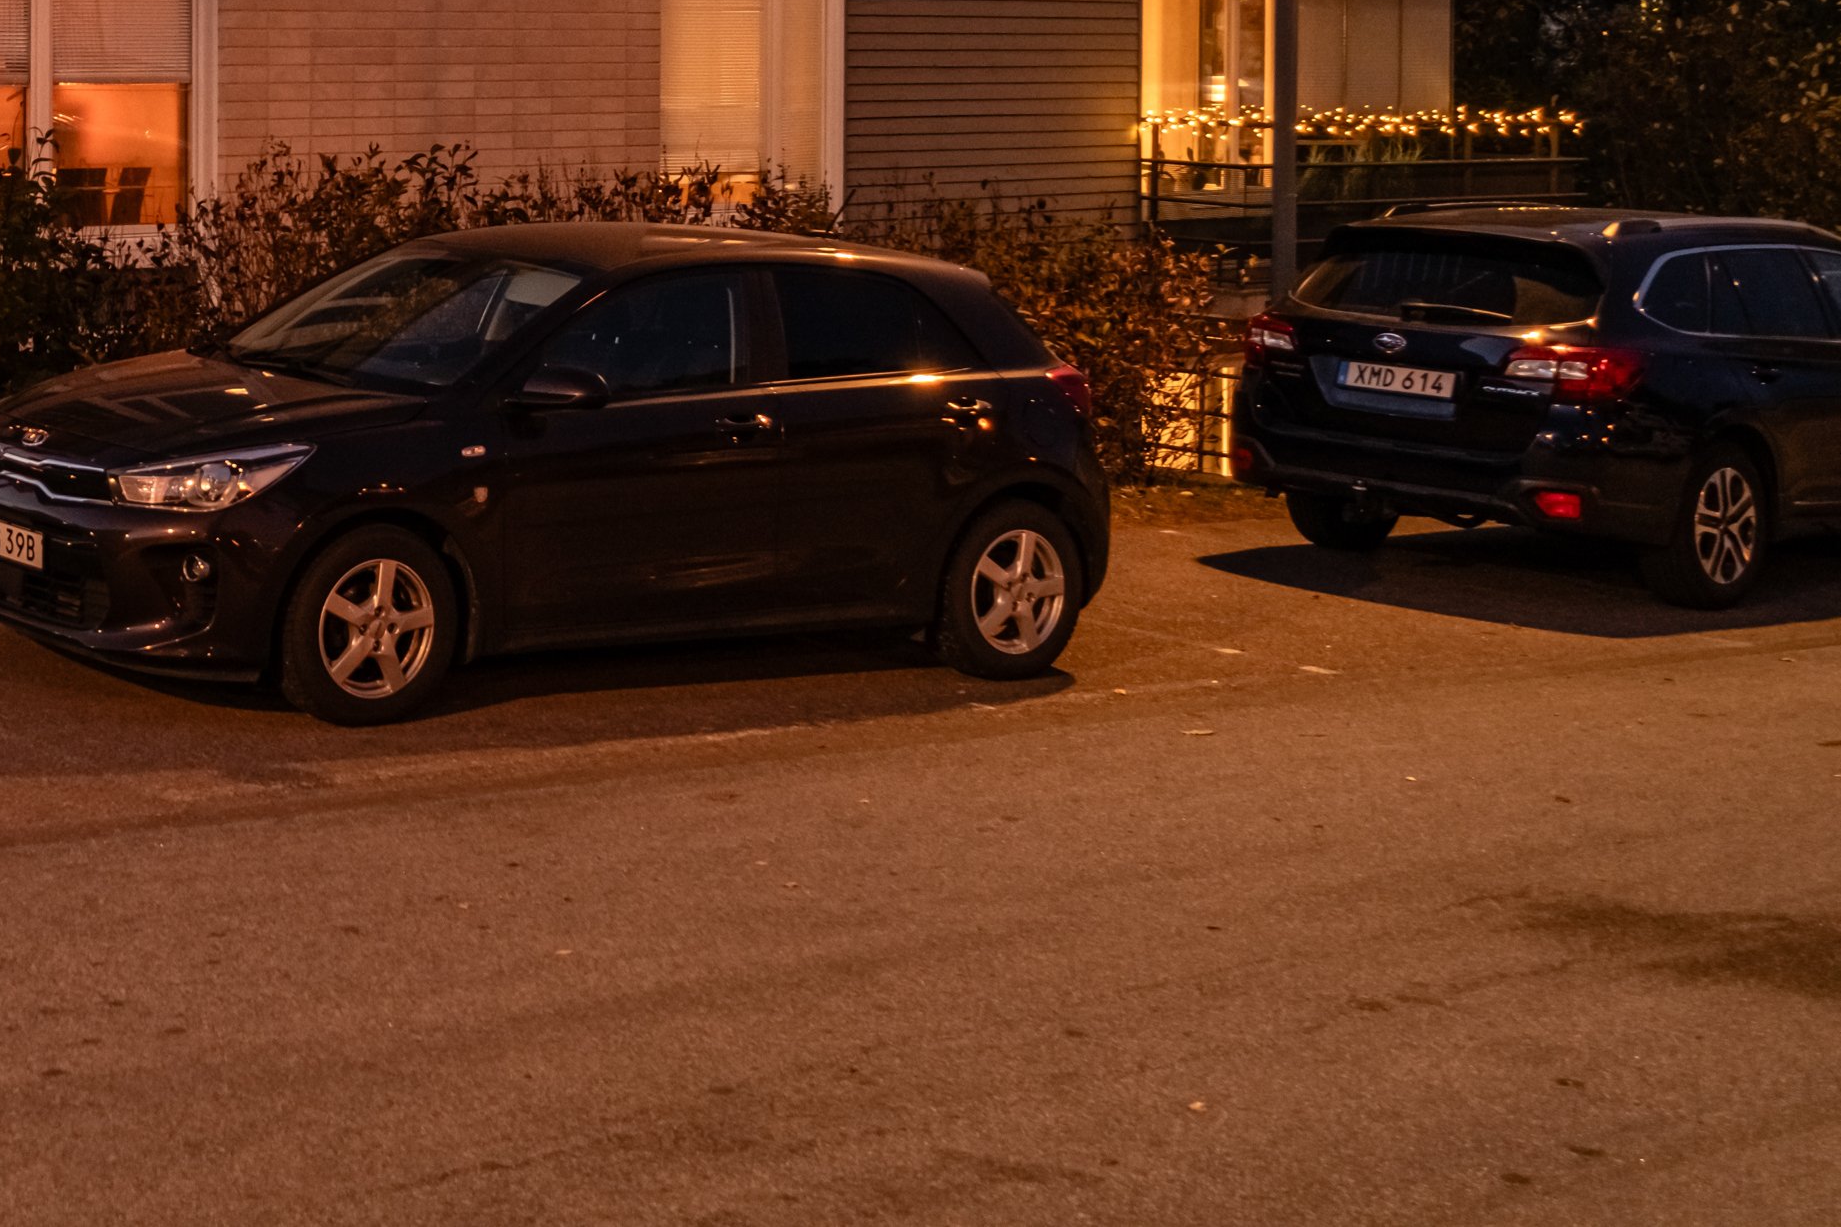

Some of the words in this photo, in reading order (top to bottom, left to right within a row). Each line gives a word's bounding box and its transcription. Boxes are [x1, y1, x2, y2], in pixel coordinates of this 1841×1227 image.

[1353, 364, 1396, 387] XMD
[1401, 370, 1444, 394] 614
[5, 527, 35, 561] 39B
